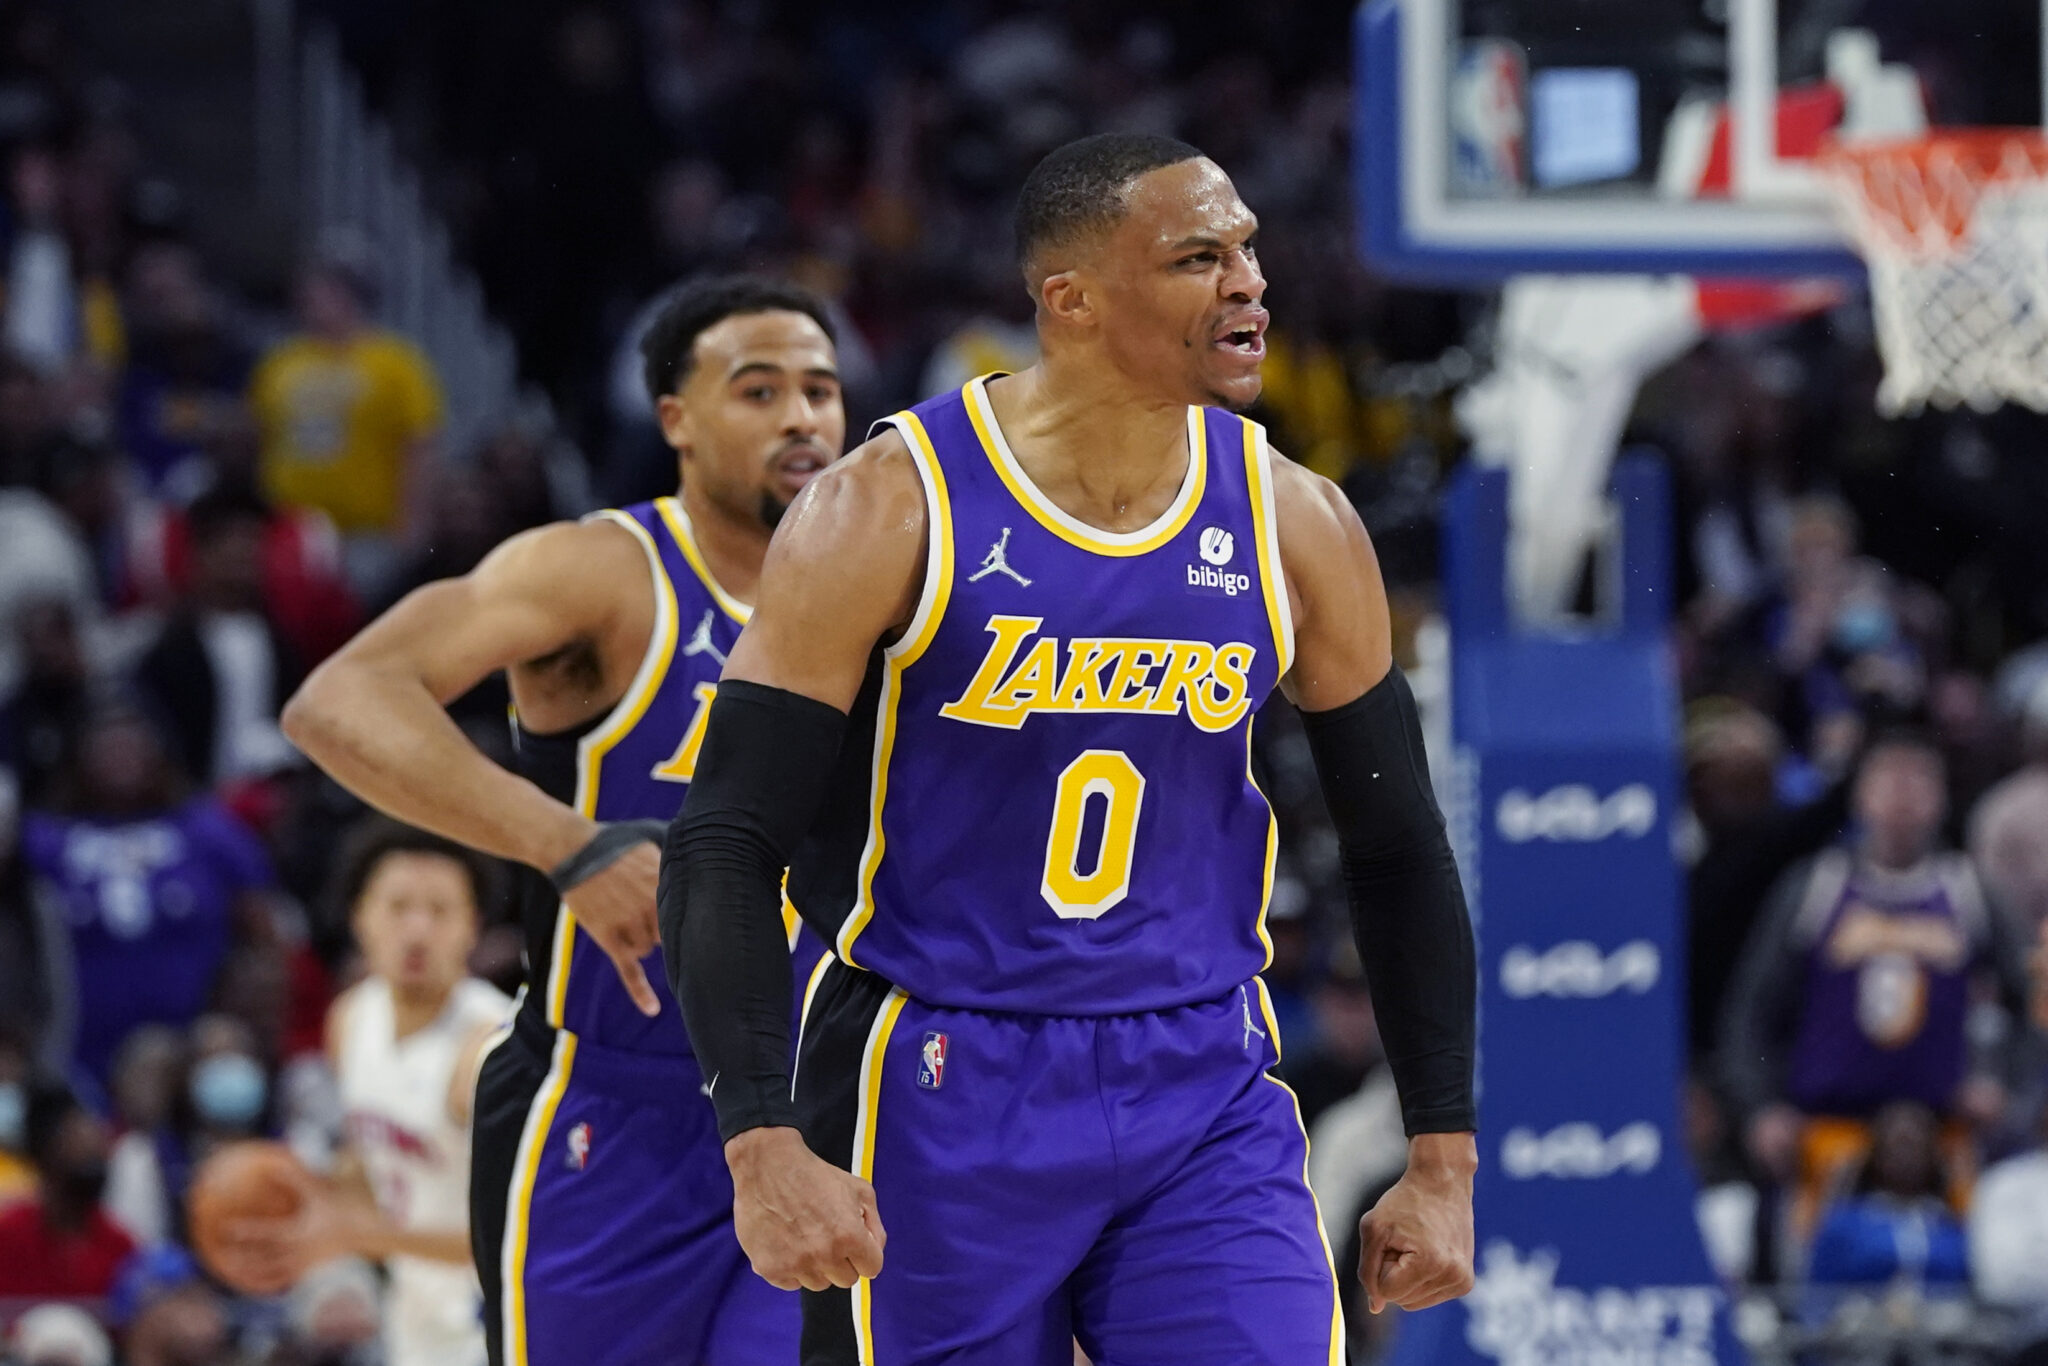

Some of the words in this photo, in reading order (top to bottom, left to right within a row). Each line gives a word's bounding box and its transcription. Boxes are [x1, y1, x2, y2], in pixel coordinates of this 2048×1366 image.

[1187, 564, 1250, 596] bibigo
[938, 614, 1257, 733] LAKERS
[1040, 749, 1146, 919] 0
